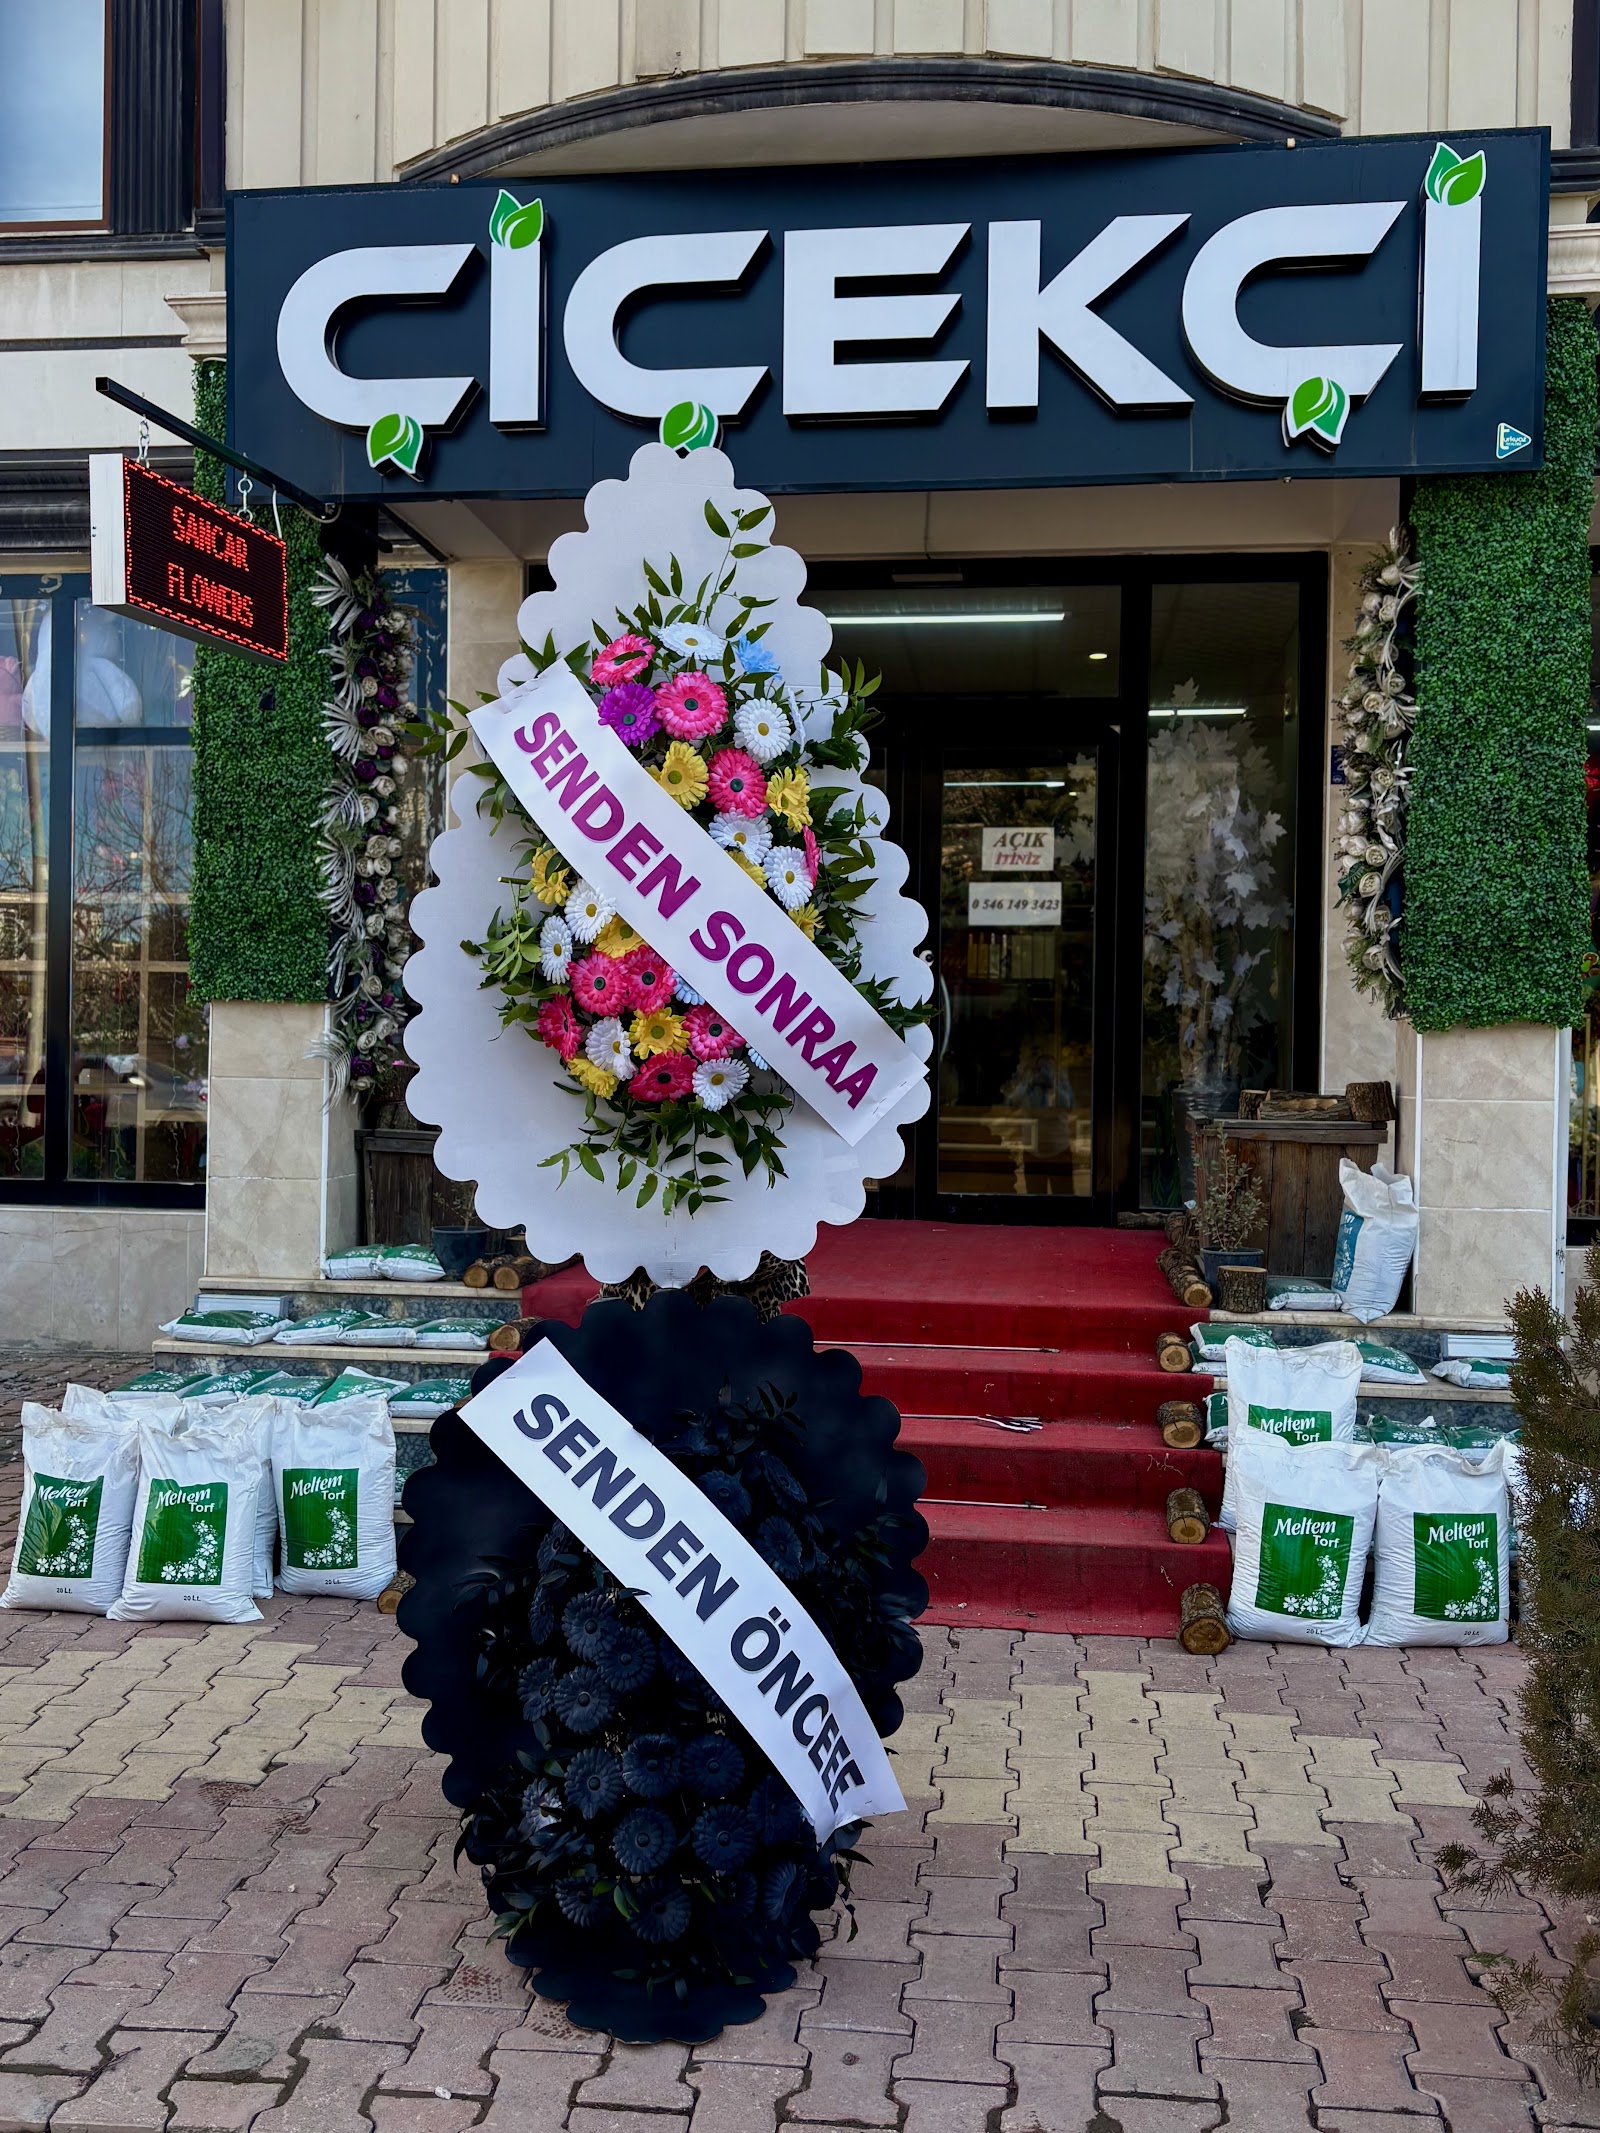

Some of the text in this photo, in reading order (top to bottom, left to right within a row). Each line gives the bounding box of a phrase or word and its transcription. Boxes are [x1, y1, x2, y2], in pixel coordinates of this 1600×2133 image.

[172, 505, 249, 572] SANCAR
[167, 562, 254, 628] FLOWERS
[993, 831, 1048, 851] AÇIK
[513, 712, 879, 1110] SENDEN SONRAA
[972, 899, 1060, 911] 0 546 149 3423
[1260, 1416, 1316, 1434] Meltem
[1294, 1431, 1320, 1442] Torf
[290, 1475, 343, 1499] Meltem
[321, 1489, 346, 1500] Torf
[64, 1497, 88, 1508] Torf
[156, 1488, 211, 1509] Meltem
[189, 1501, 215, 1513] Torf
[1274, 1517, 1337, 1537] Meltem
[1427, 1521, 1485, 1545] Meltem
[1313, 1535, 1340, 1548] Torf
[1466, 1537, 1490, 1549] Torf
[513, 1393, 866, 1811] SENDEN ÖNCEEE
